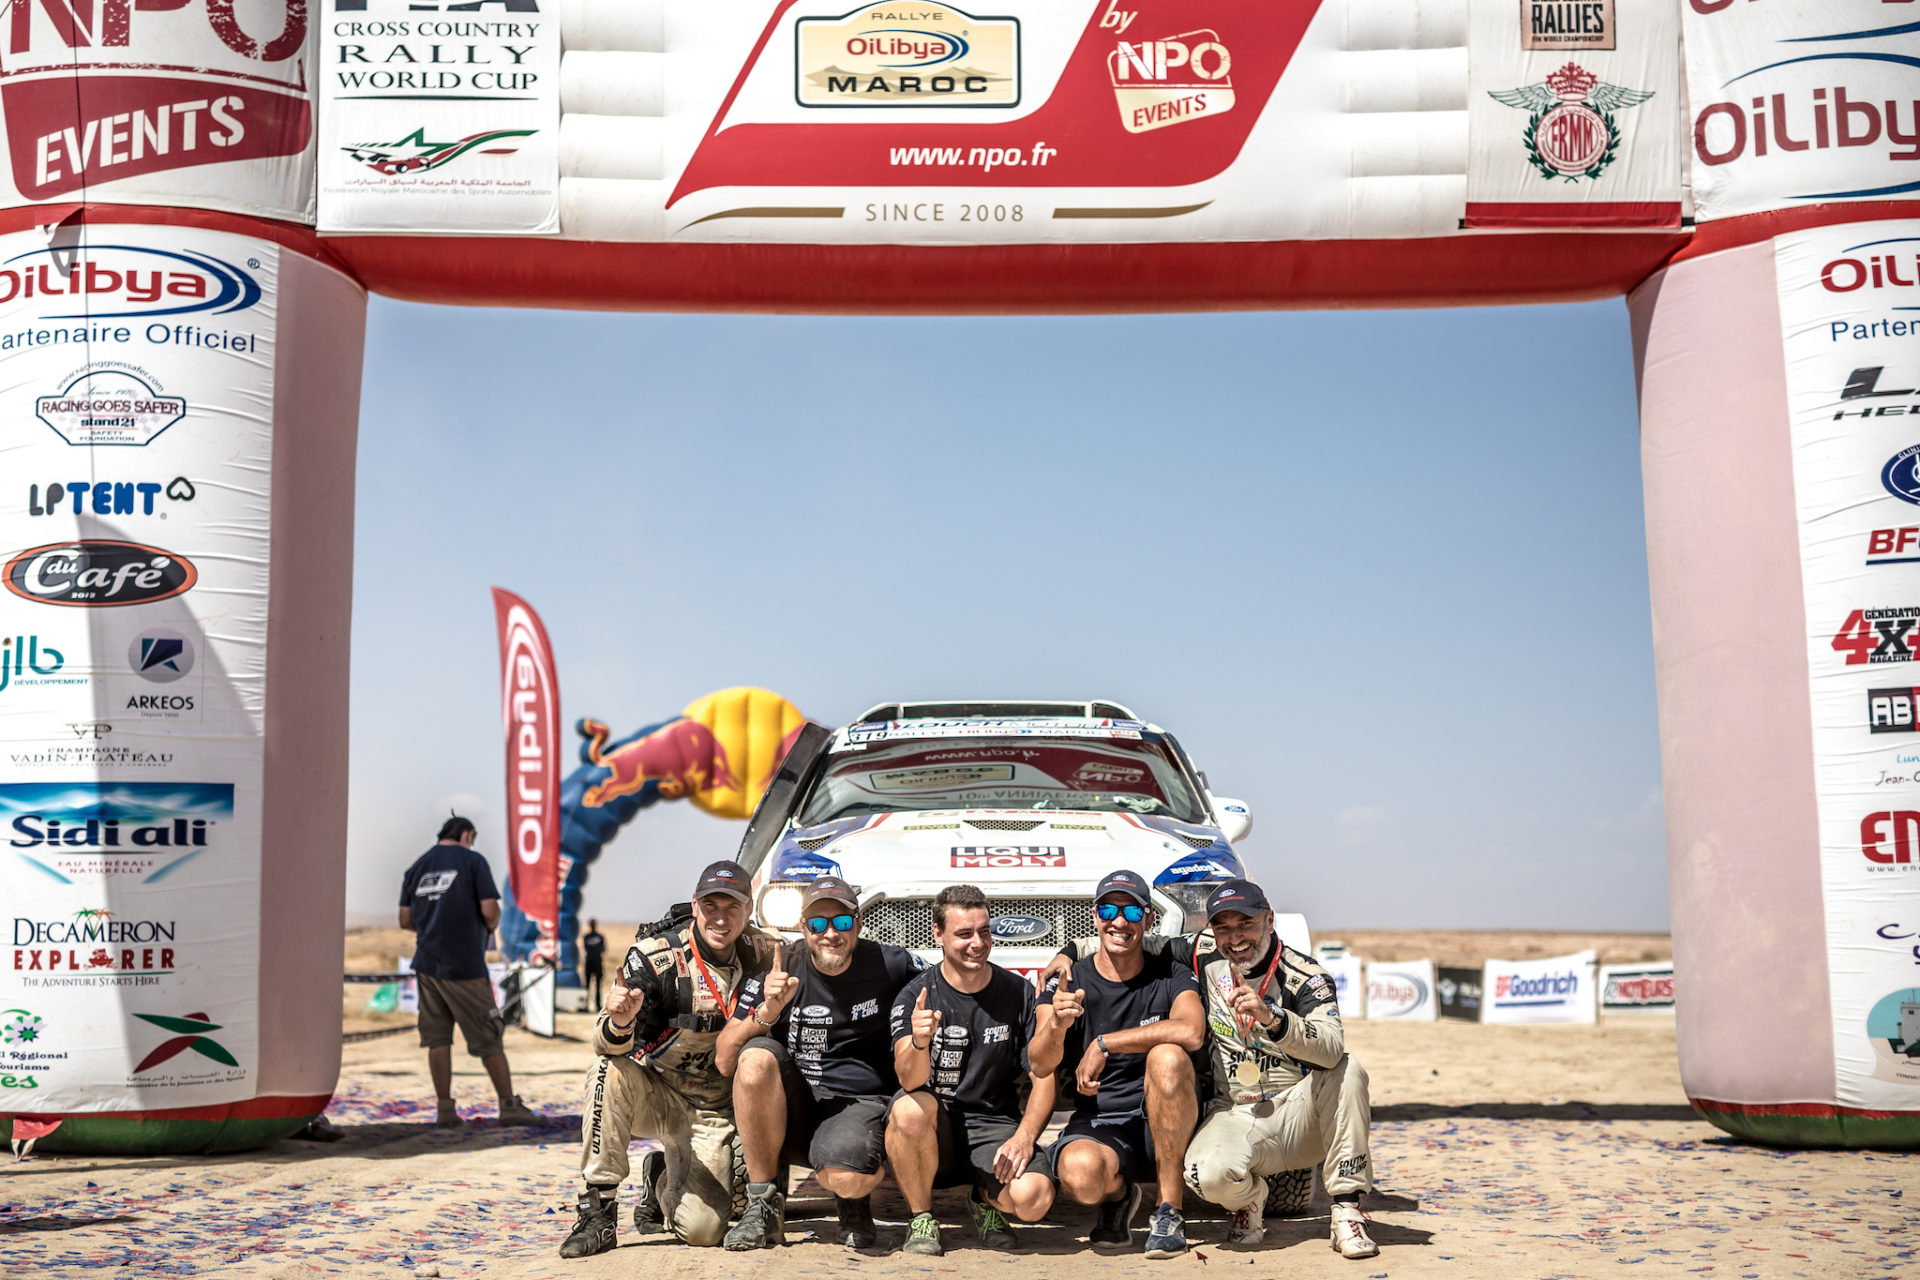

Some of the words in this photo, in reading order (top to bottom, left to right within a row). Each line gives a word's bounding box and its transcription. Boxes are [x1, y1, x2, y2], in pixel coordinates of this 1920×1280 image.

[871, 12, 943, 21] RALLYE
[1099, 0, 1138, 34] by
[1532, 3, 1604, 34] RALLIES
[334, 22, 410, 38] CROSS
[417, 22, 541, 38] COUNTRY
[337, 44, 537, 64] RALLY
[846, 37, 947, 61] OiLibya
[1117, 40, 1232, 81] NPO
[337, 71, 462, 90] WORLD
[471, 72, 539, 90] CUP
[827, 76, 988, 93] MAROC
[1133, 94, 1207, 128] EVENTS
[36, 96, 245, 187] EVENTS
[1552, 113, 1594, 162] FRMM
[890, 141, 1057, 173] www.npo.fr
[867, 204, 945, 222] SINCE
[961, 204, 1024, 222] 2008
[146, 324, 255, 353] Officiel
[42, 400, 91, 414] RACING
[93, 400, 131, 412] GOES
[134, 401, 179, 416] SAFER
[1869, 654, 1912, 664] MAGAZINE
[127, 696, 194, 710] ARKEOS
[852, 731, 887, 742] 319
[513, 654, 543, 865] OiLibya
[10, 815, 122, 848] Sidi
[131, 818, 208, 847] ali
[956, 847, 1060, 857] LIQUI
[88, 859, 154, 867] MINÉRALE
[956, 857, 1061, 867] MOLY
[14, 918, 176, 946] DECAMERON
[996, 917, 1035, 935] Ford
[22, 977, 39, 987] THE
[42, 977, 97, 988] ADVENTURE
[99, 977, 133, 987] STARTS
[135, 976, 160, 986] HERE
[1494, 971, 1579, 998] BFGoodrich
[852, 999, 877, 1012] SOUTH
[1140, 1015, 1160, 1027] SOUTH
[1213, 1020, 1234, 1032] MANN
[802, 1028, 826, 1036] LIQUI
[984, 1025, 1009, 1036] SOUTH
[9, 1051, 68, 1061] Régional
[1339, 1154, 1366, 1169] SOUTH
